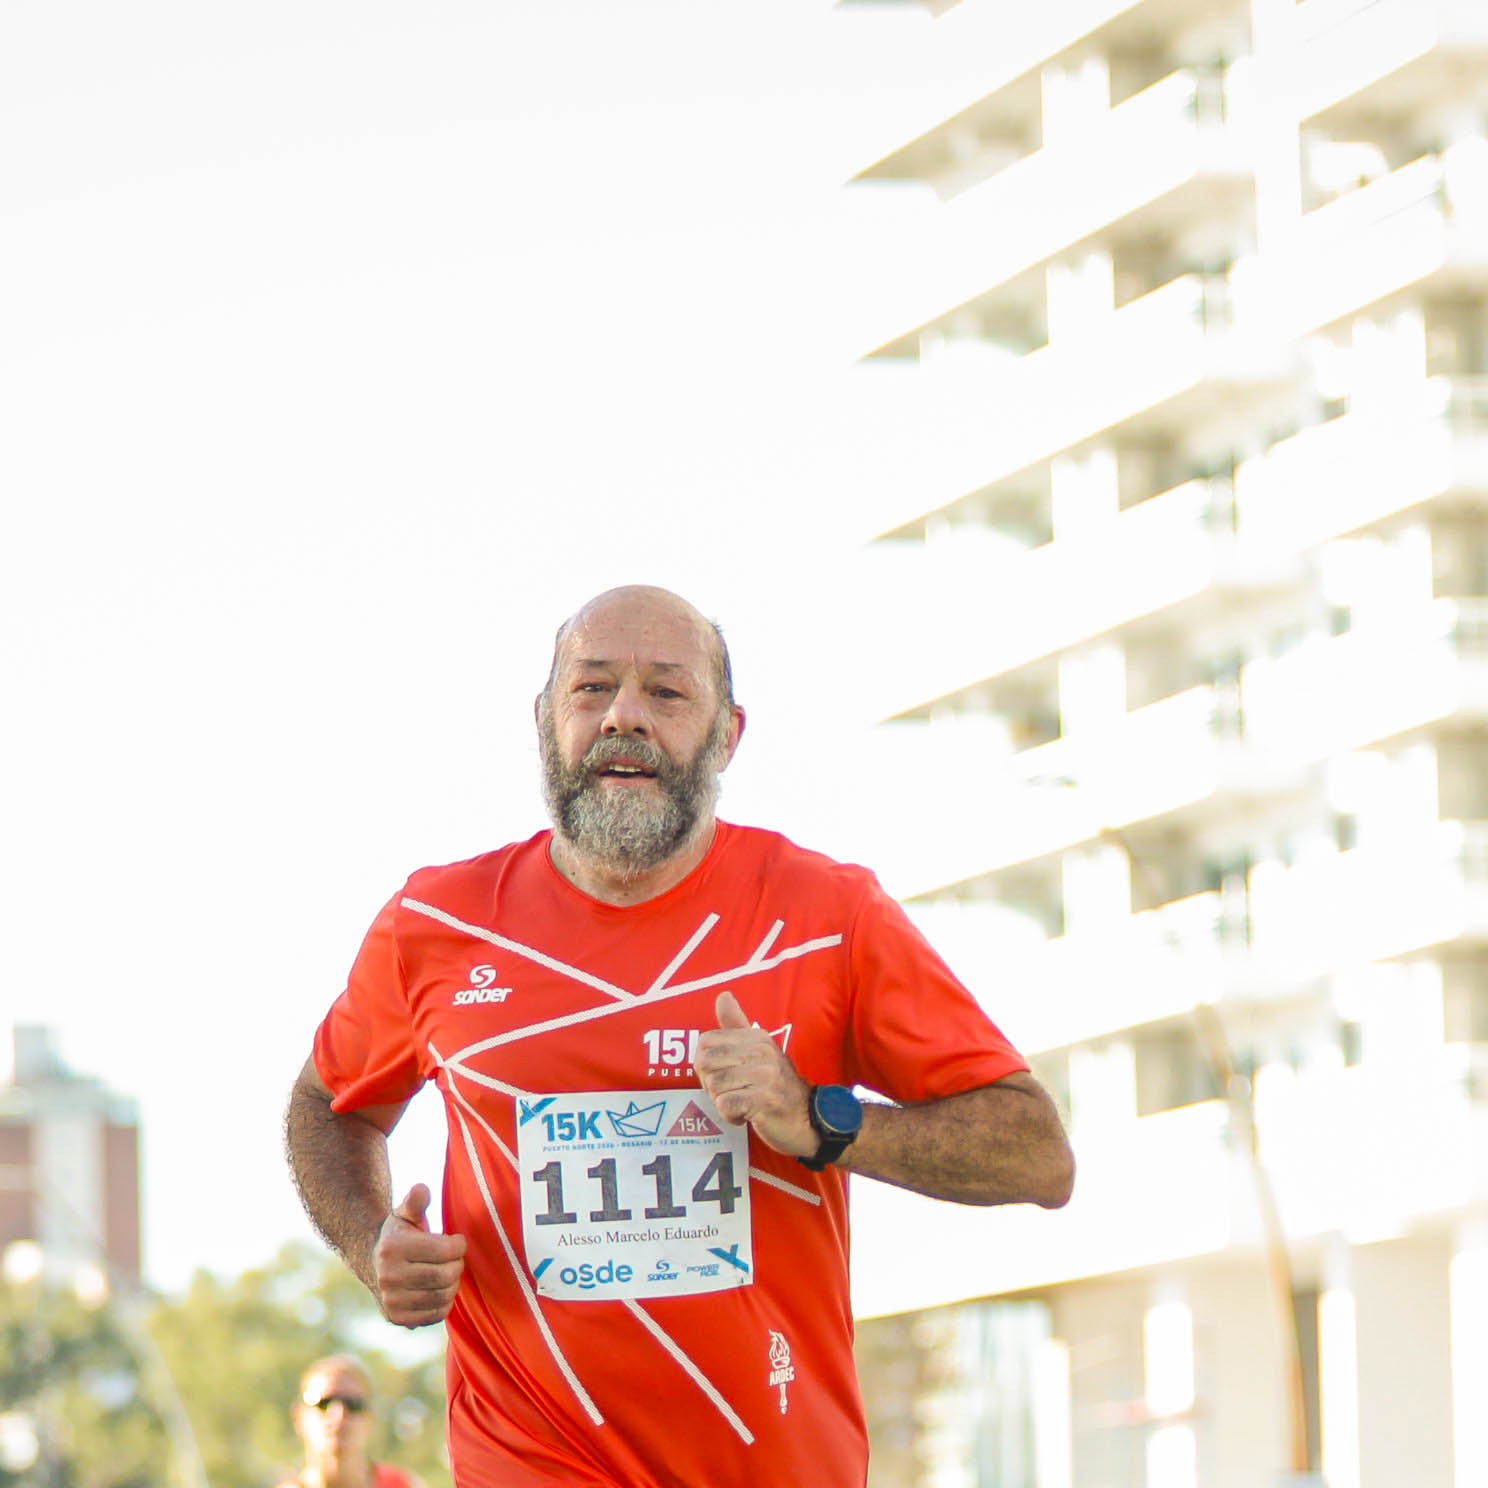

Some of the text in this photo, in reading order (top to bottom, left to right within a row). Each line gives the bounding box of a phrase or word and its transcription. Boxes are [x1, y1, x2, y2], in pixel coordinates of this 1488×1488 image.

[541, 1111, 603, 1142] 15K
[678, 1117, 709, 1132] 15K
[532, 1151, 743, 1226] 1114
[557, 1224, 720, 1247] Alesso Marcelo Eduardo
